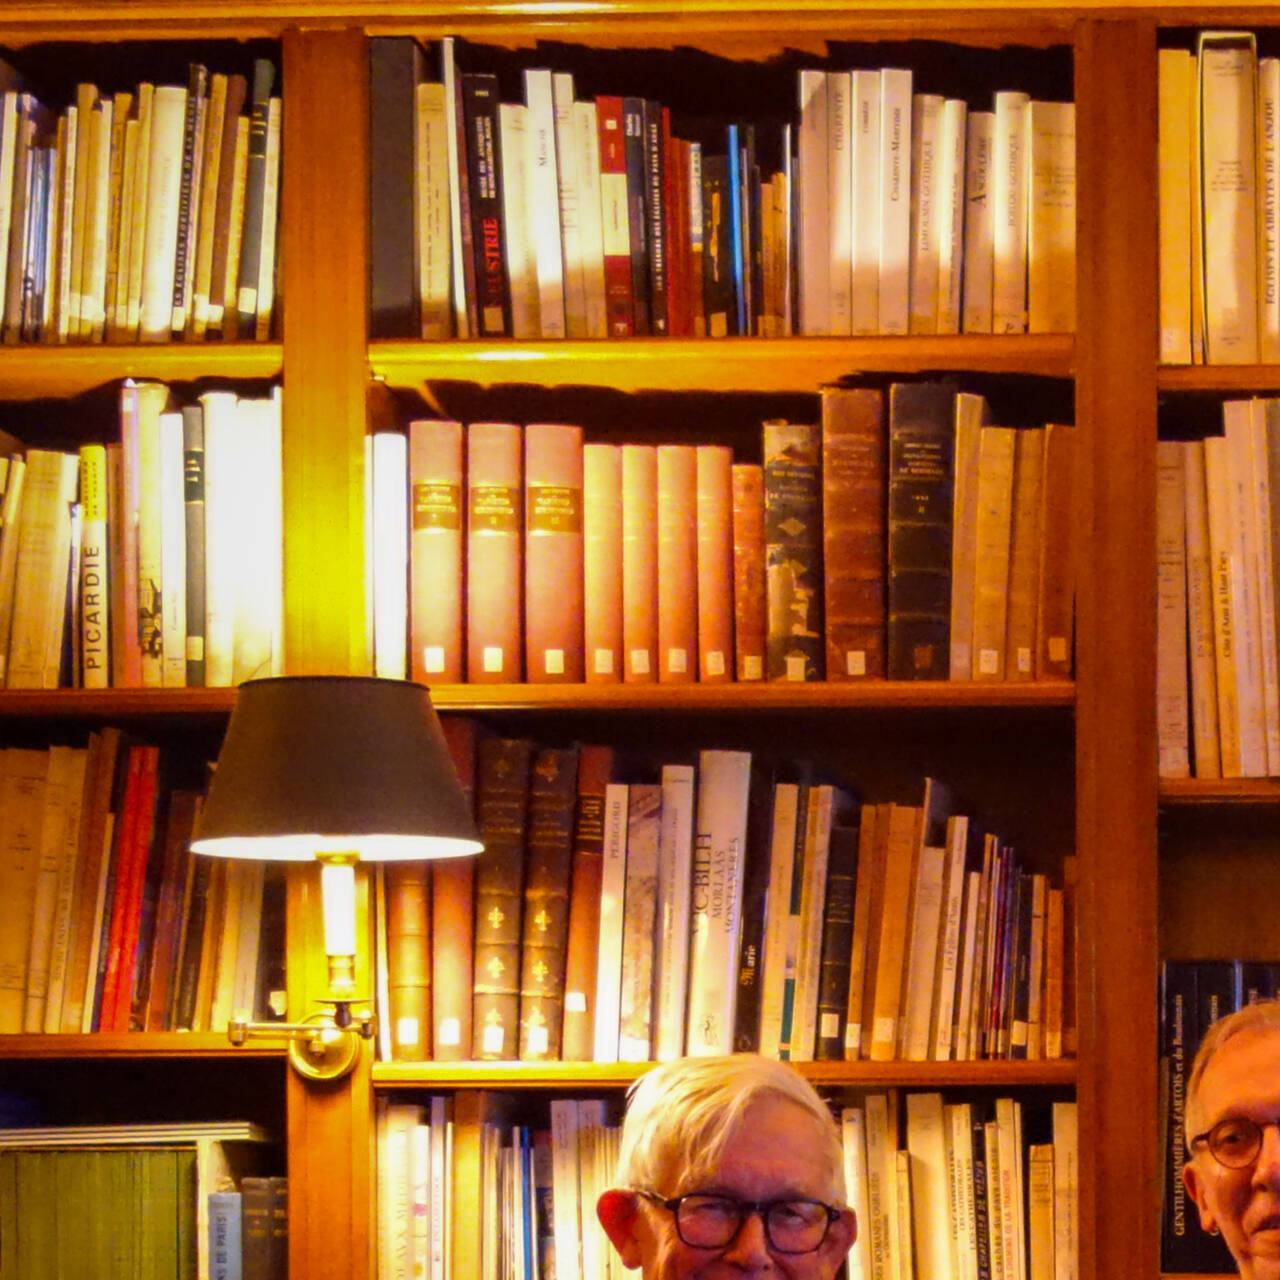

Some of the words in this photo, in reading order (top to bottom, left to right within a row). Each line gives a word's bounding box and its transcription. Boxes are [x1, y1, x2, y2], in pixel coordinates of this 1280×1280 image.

[85, 546, 102, 669] PICARDIE
[1173, 1048, 1183, 1060] du
[1174, 1063, 1183, 1072] et
[1172, 1074, 1184, 1122] d'ARTOIS
[216, 1216, 228, 1246] PARIS
[216, 1251, 228, 1263] DE
